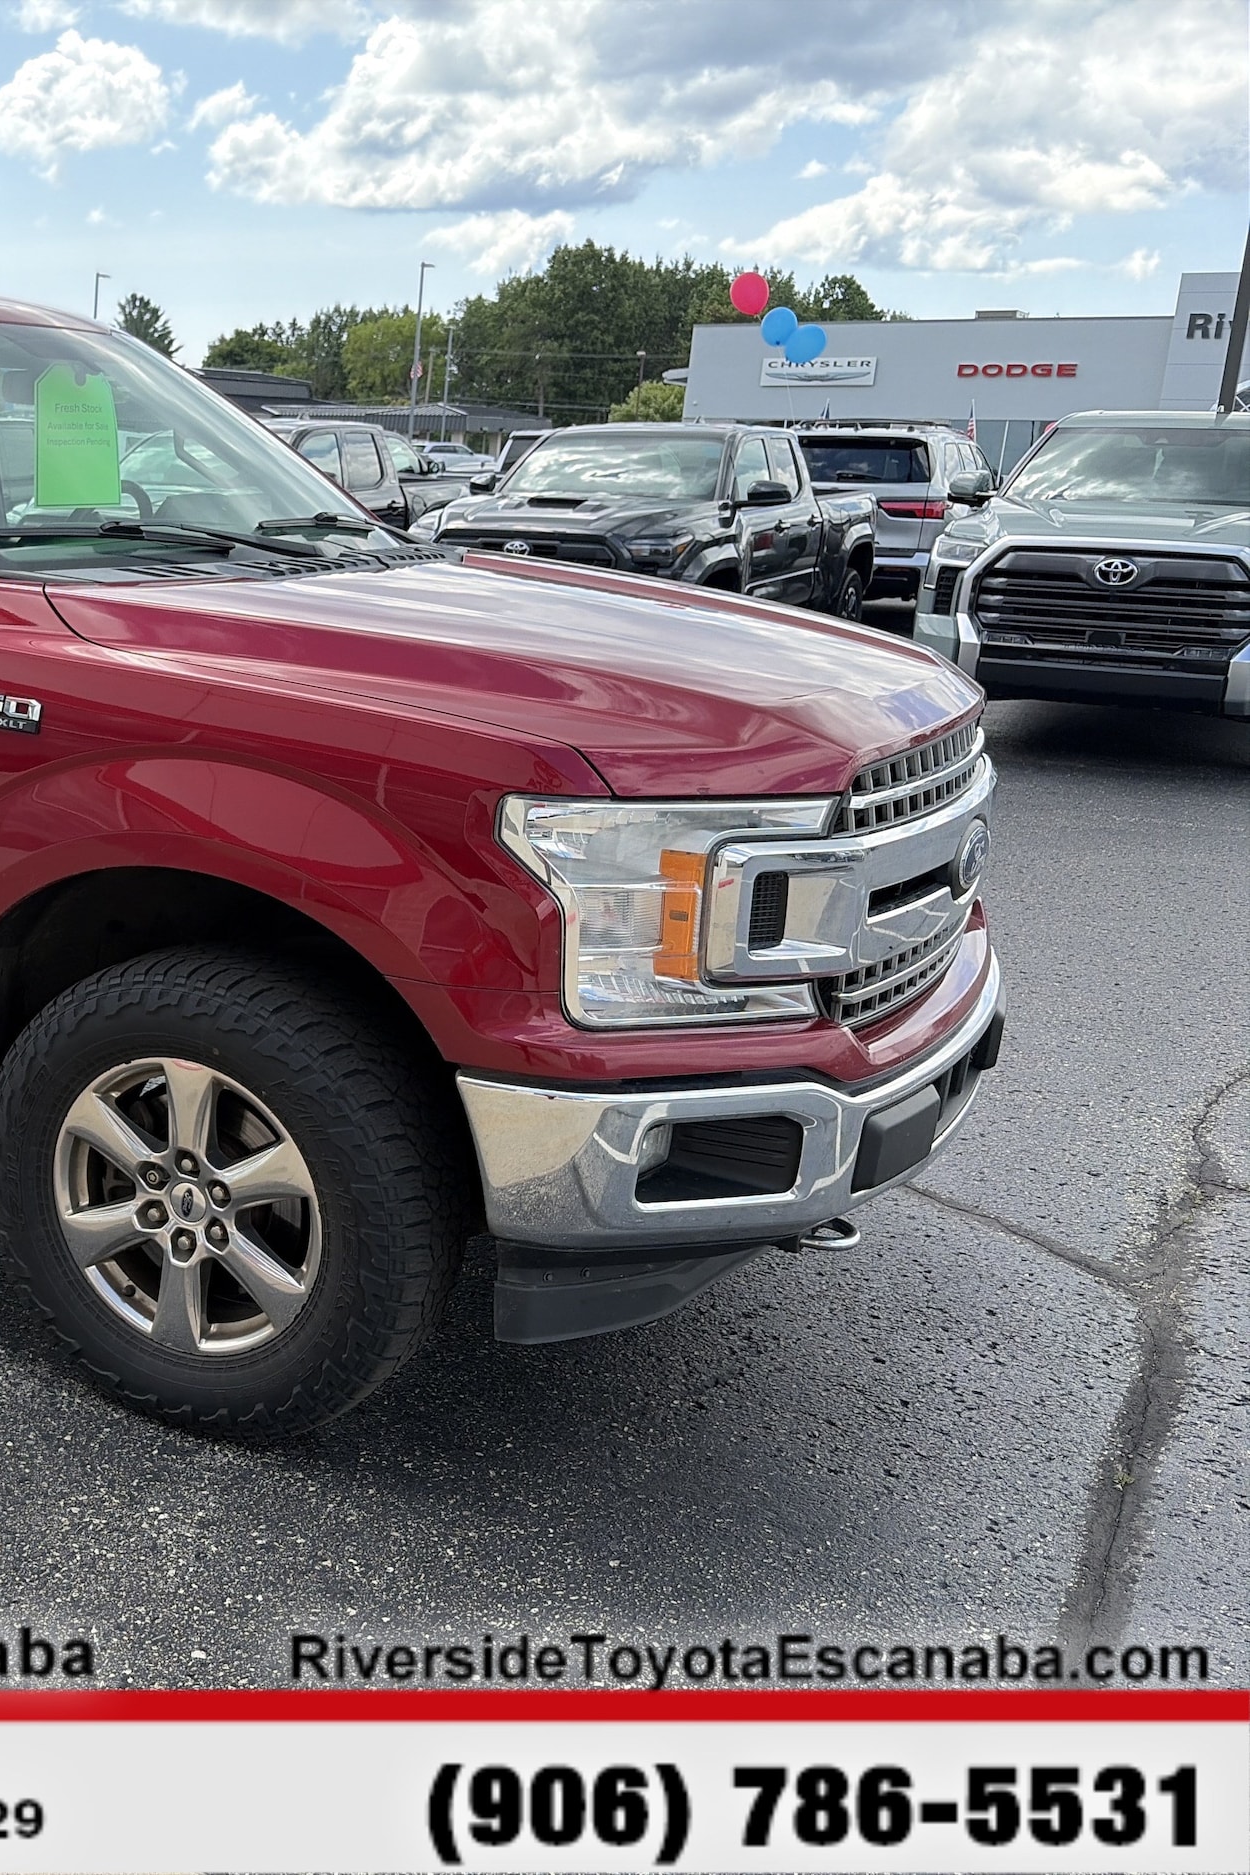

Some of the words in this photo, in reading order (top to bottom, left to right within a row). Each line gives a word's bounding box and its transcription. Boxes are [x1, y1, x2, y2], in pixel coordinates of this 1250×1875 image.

[1186, 313, 1234, 340] Ri
[768, 360, 871, 368] CHRYSLER
[957, 363, 1078, 378] DODGE
[54, 403, 80, 413] Fresh
[81, 404, 103, 413] Stock
[47, 422, 84, 430] Available
[84, 422, 94, 430] for
[47, 438, 86, 447] Inspection
[86, 438, 111, 448] Pending
